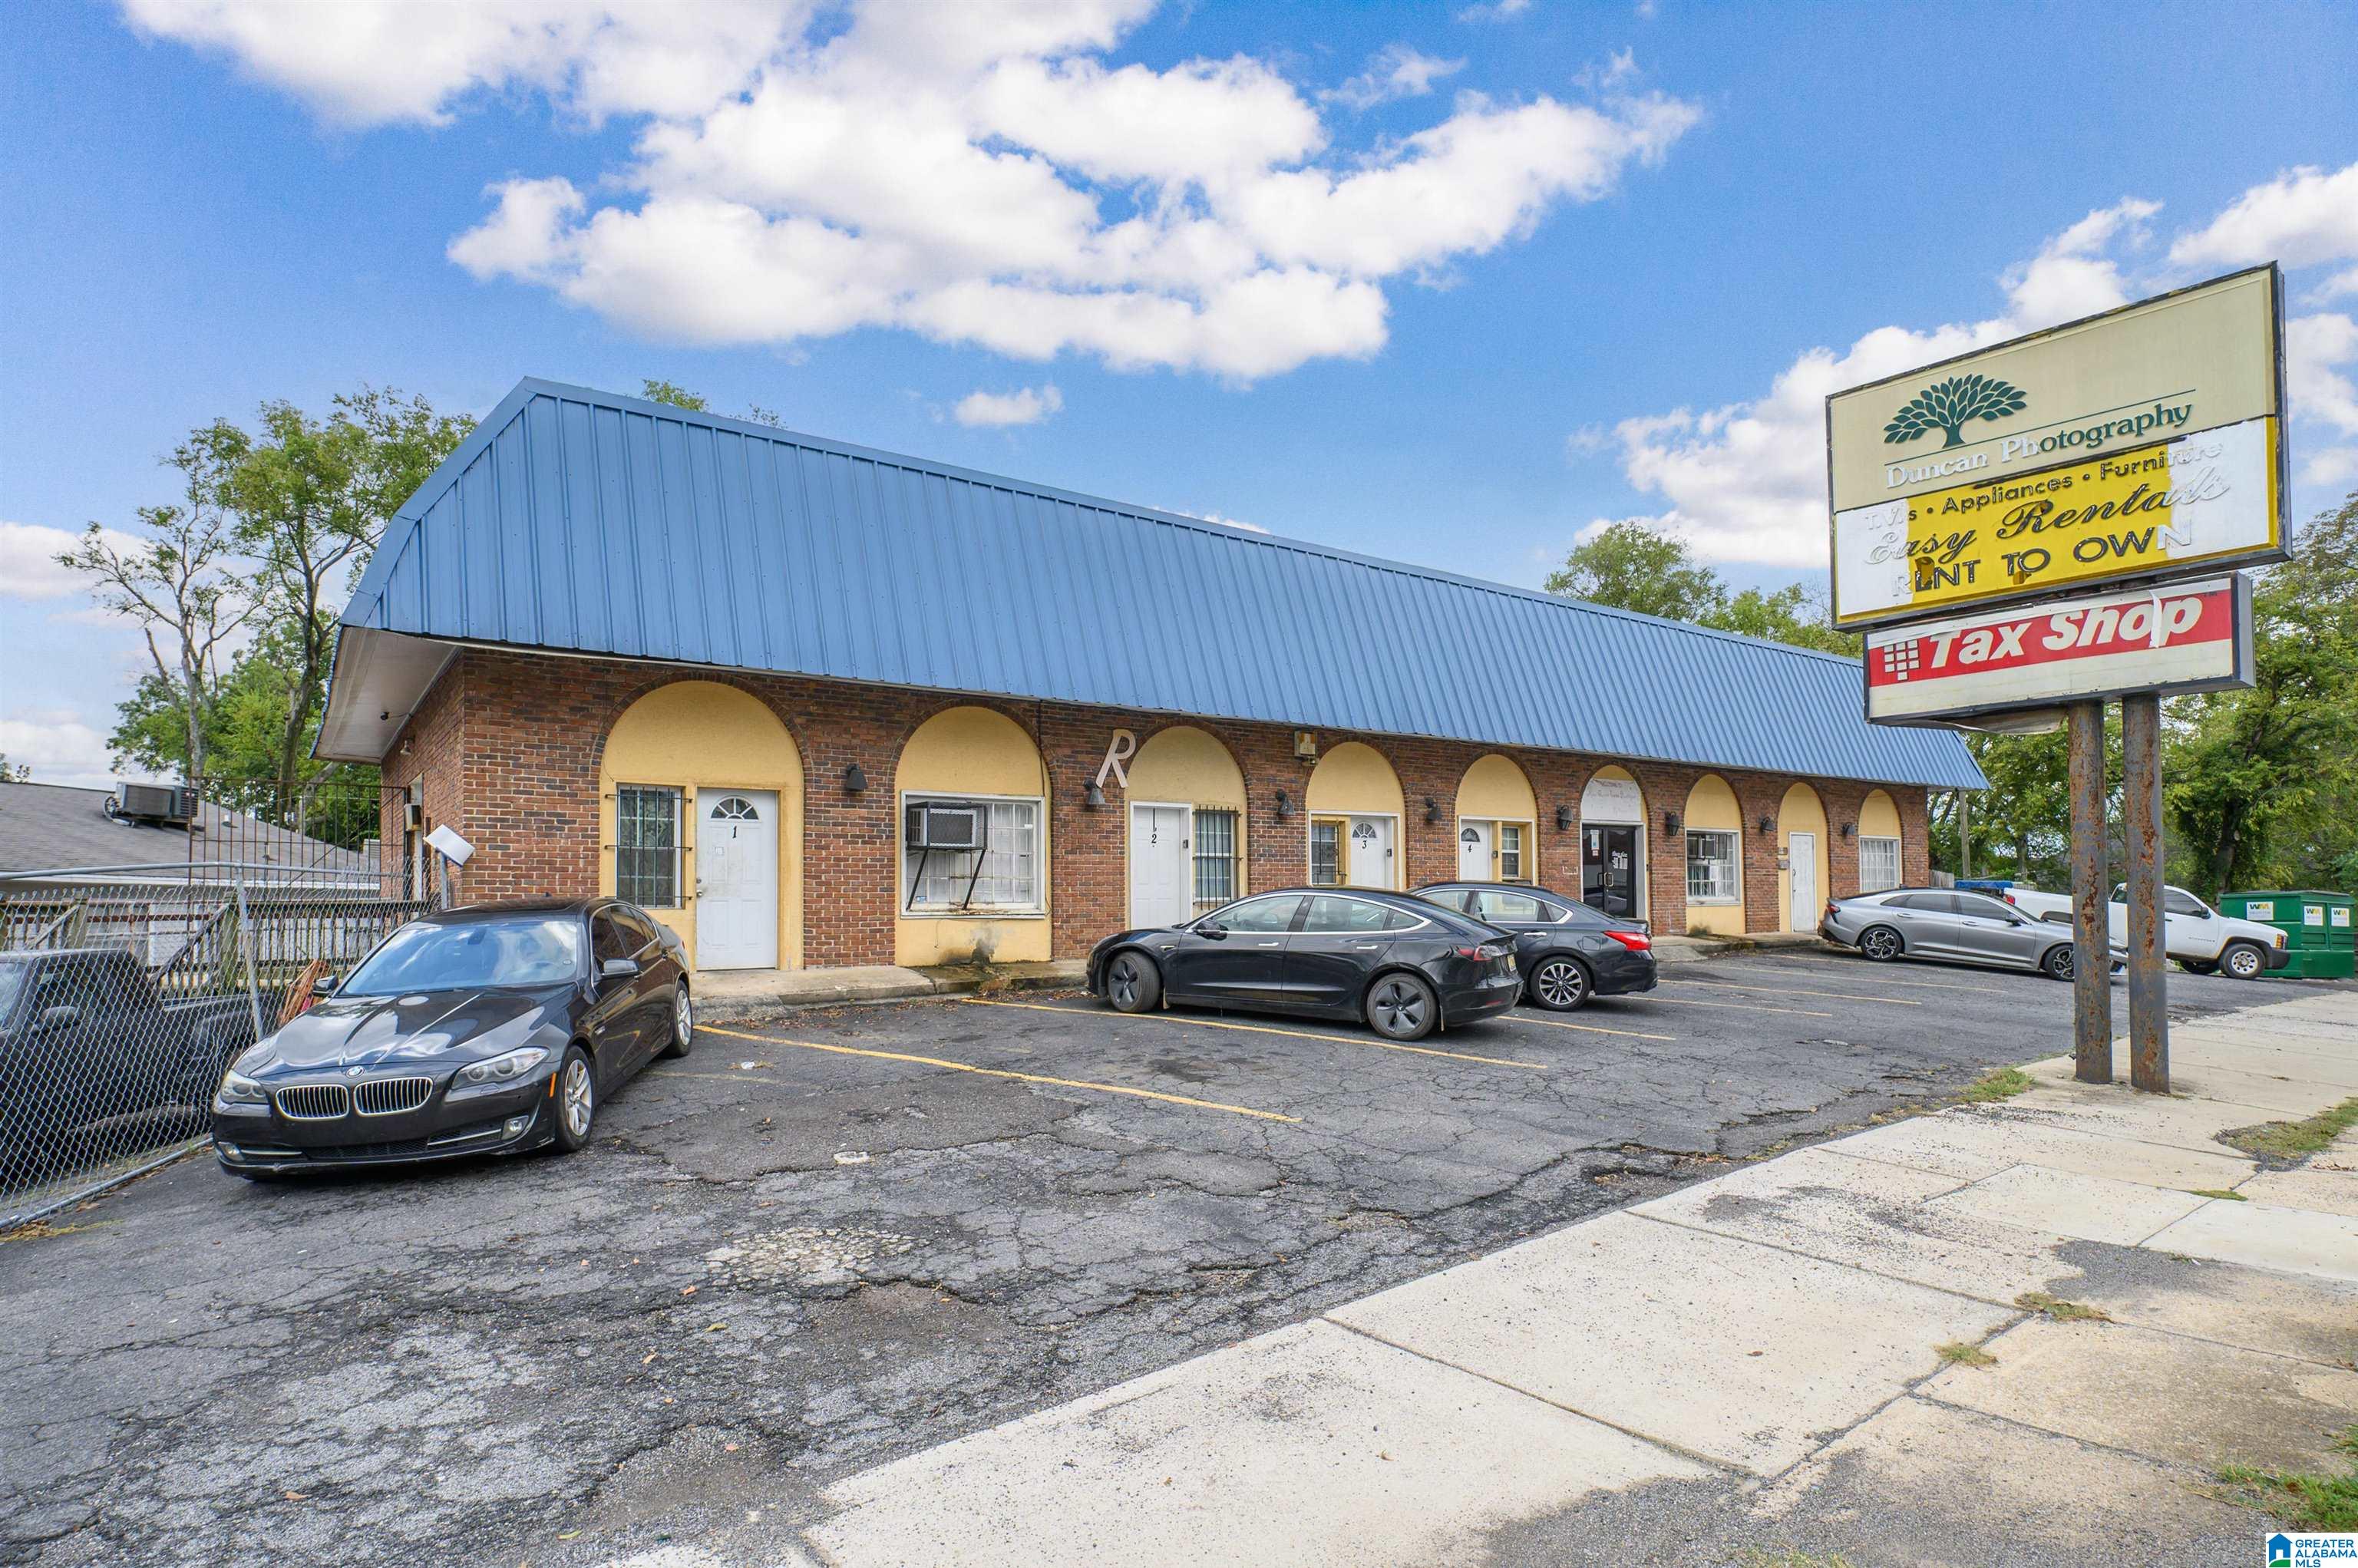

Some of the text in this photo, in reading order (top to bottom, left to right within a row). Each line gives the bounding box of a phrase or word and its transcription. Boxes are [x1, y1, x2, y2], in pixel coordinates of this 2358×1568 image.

[1887, 403, 2192, 488] Duncan Photography
[1941, 474, 2072, 514] Appliances
[1864, 529, 1977, 565] Easy
[2001, 548, 2051, 576] TO
[2073, 519, 2192, 562] OWN
[1930, 597, 2203, 668] Tax Shop
[1095, 728, 1136, 788] R
[732, 825, 737, 839] 1
[1151, 834, 1157, 844] 2
[1362, 840, 1367, 850] 3
[1468, 844, 1472, 853] 4
